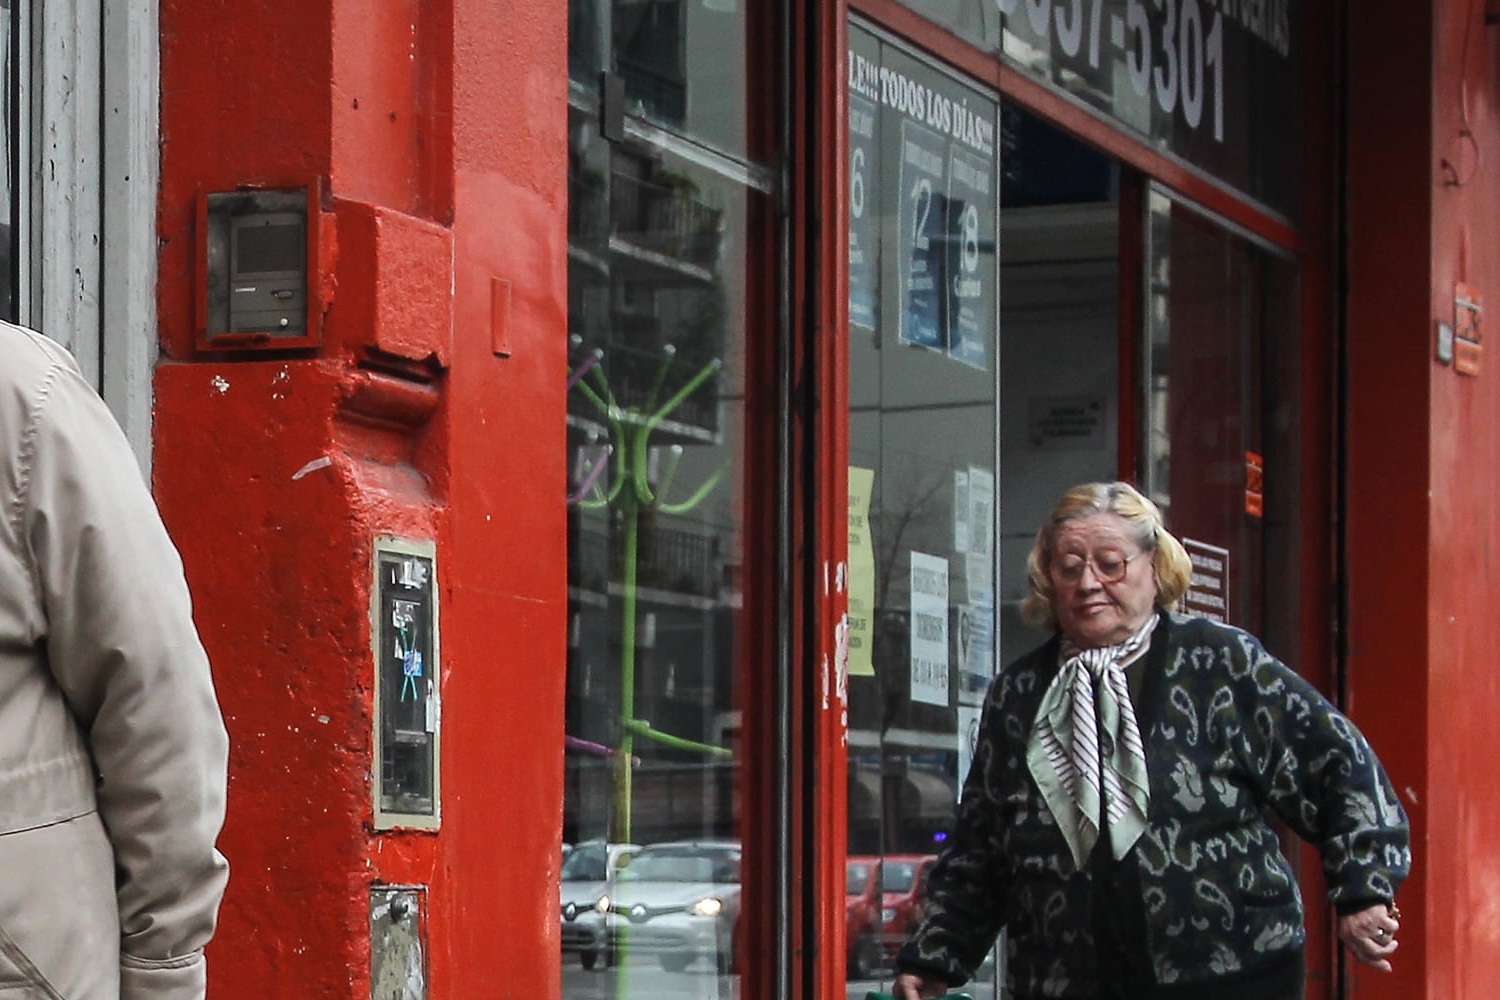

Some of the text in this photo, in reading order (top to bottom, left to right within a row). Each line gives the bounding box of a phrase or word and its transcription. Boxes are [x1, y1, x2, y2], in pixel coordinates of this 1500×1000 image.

[879, 66, 925, 121] TODOS
[926, 88, 951, 134] LOS
[851, 147, 866, 219] 6
[911, 176, 932, 250] 12
